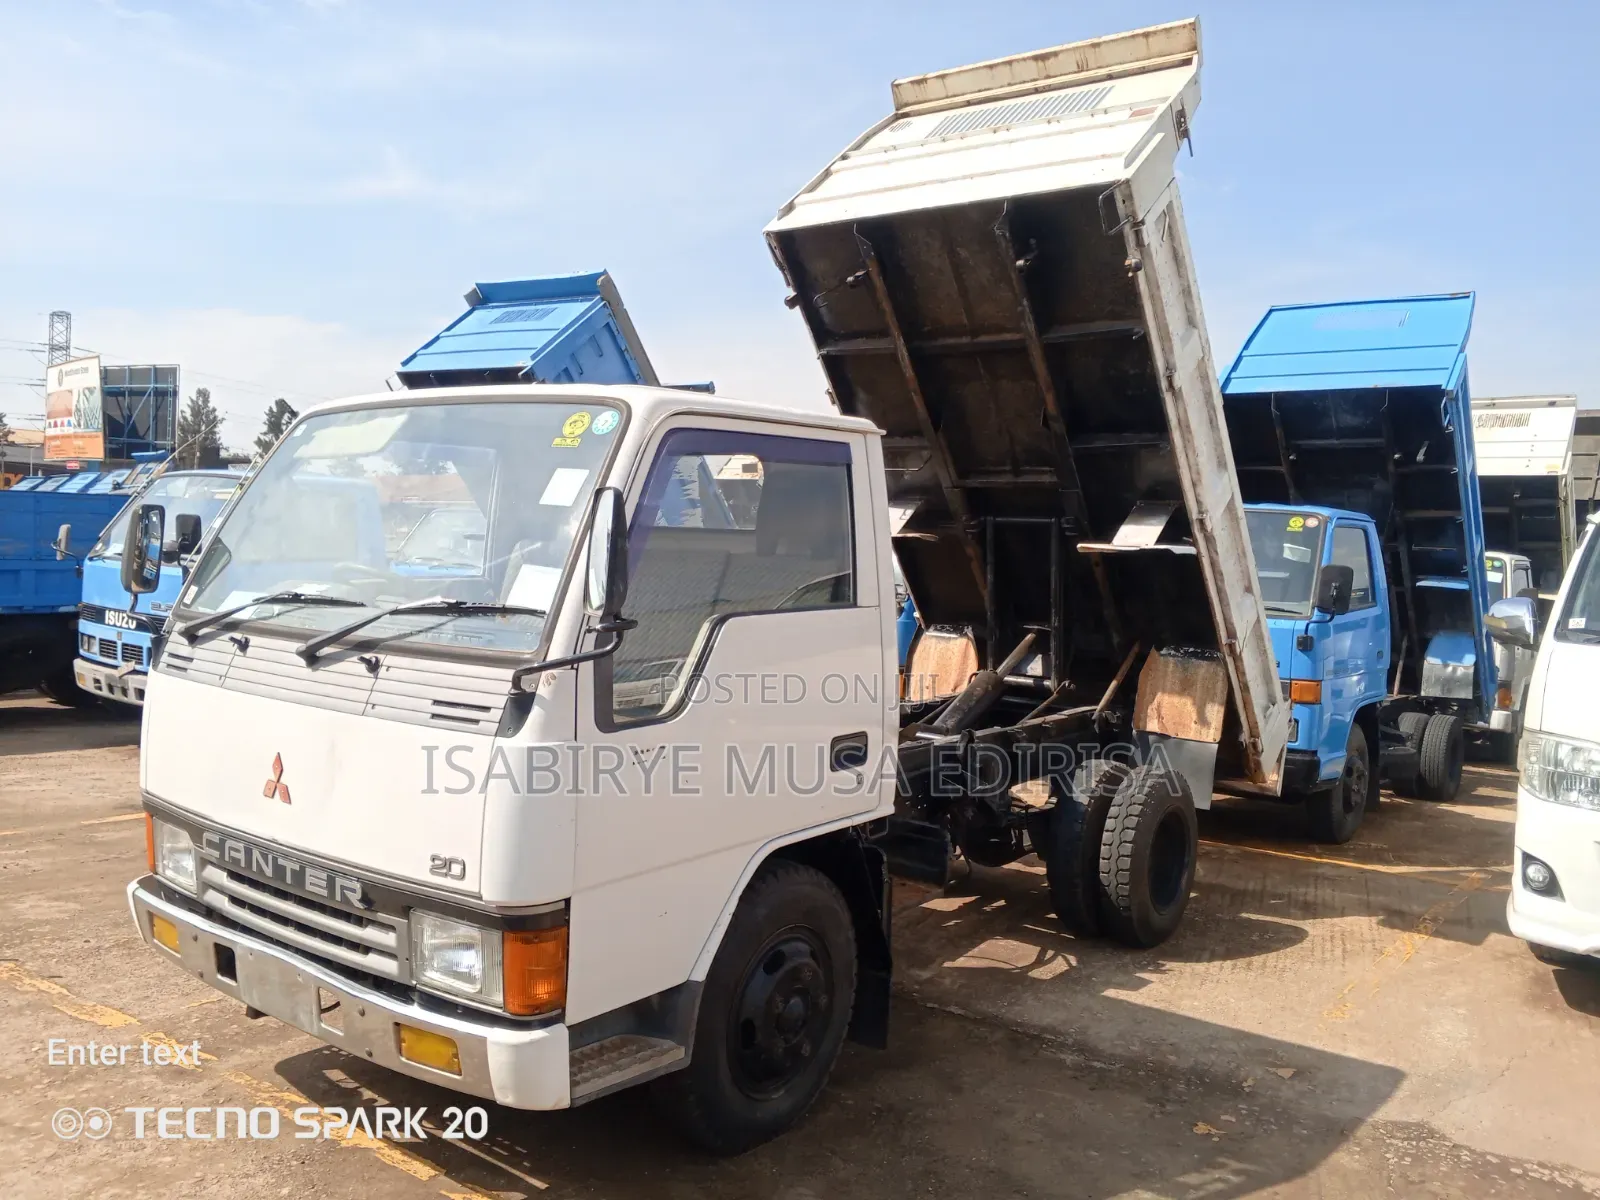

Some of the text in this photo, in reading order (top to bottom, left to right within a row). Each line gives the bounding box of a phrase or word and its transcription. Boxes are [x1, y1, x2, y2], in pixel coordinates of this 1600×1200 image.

[105, 610, 136, 629] ISUZU
[202, 832, 366, 909] CANTER
[429, 853, 466, 880] 20
